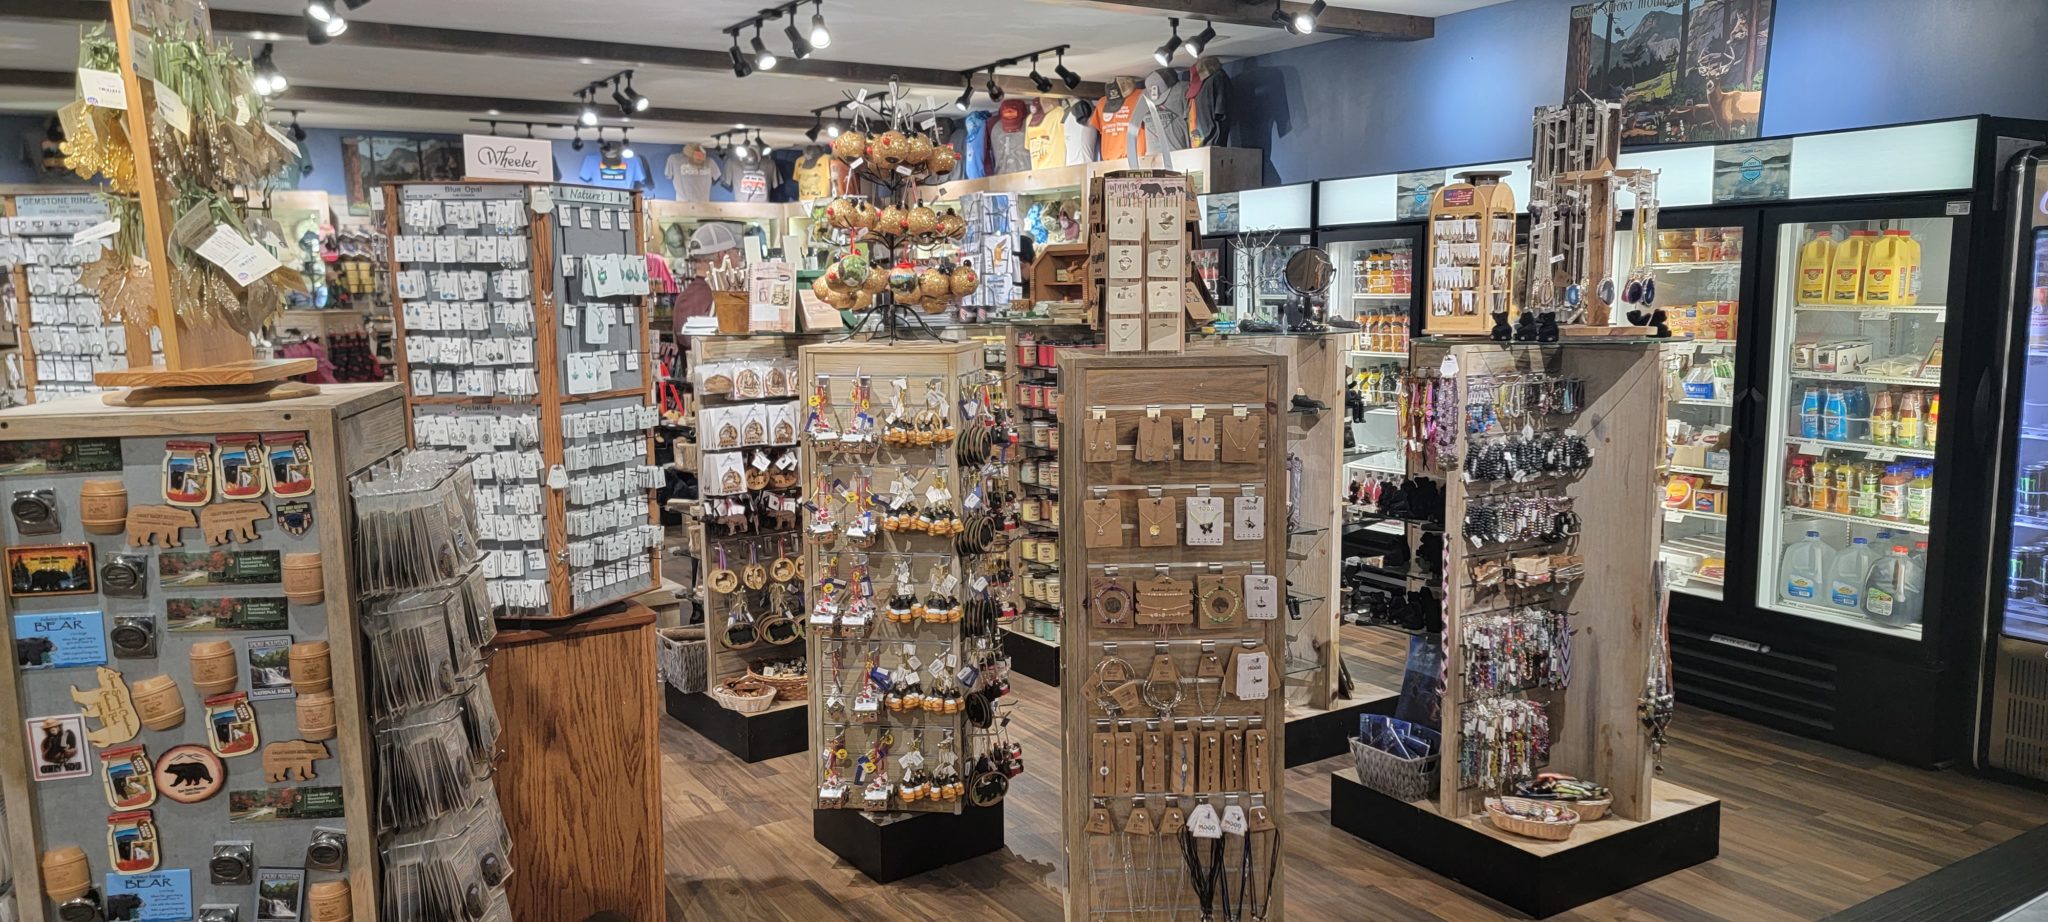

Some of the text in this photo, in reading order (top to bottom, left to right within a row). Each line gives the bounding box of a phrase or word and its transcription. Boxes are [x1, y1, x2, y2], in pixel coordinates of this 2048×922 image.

[477, 145, 538, 168] Wheeler
[465, 186, 482, 194] Opal
[570, 189, 605, 201] Nature's
[71, 196, 98, 204] RINGS
[34, 620, 85, 632] BEAR
[125, 878, 173, 889] BEAR
